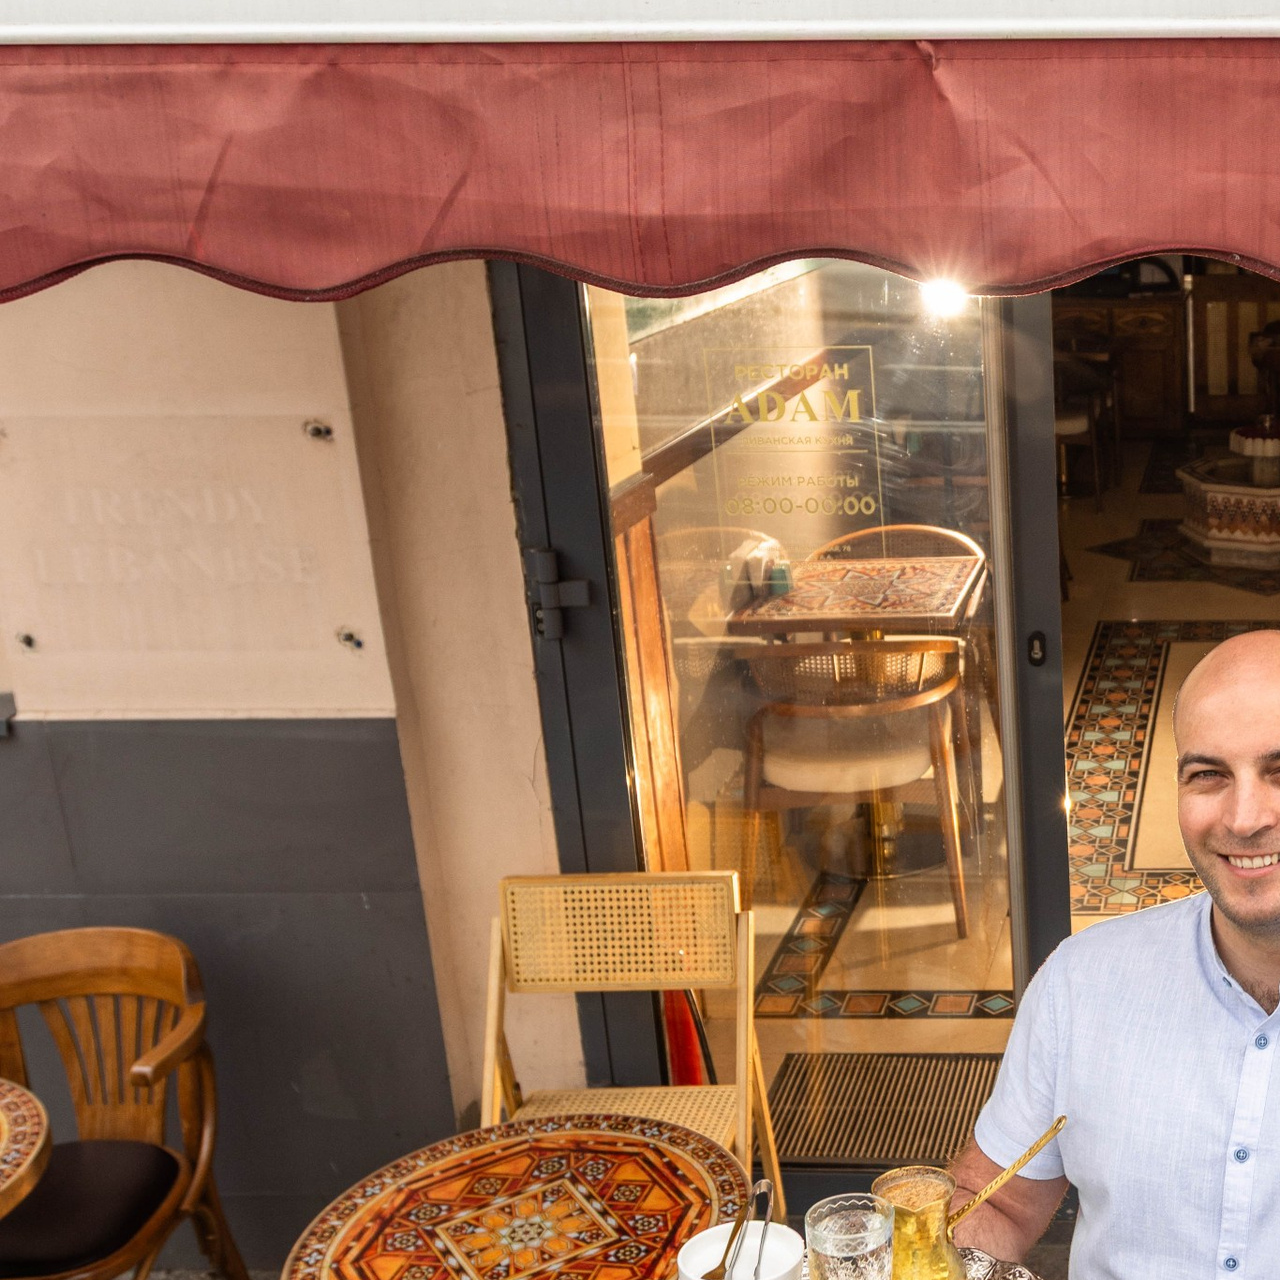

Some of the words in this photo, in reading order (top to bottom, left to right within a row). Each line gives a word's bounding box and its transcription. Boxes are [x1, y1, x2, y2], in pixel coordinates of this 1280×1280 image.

[734, 363, 849, 381] РЕСТОРАН
[725, 389, 861, 423] ADAM
[742, 436, 812, 446] ЛИВАНСКАЯ
[738, 476, 792, 488] РЕЖИМ
[797, 474, 860, 488] РАБОТЫ
[726, 497, 876, 515] 08:00-00:00
